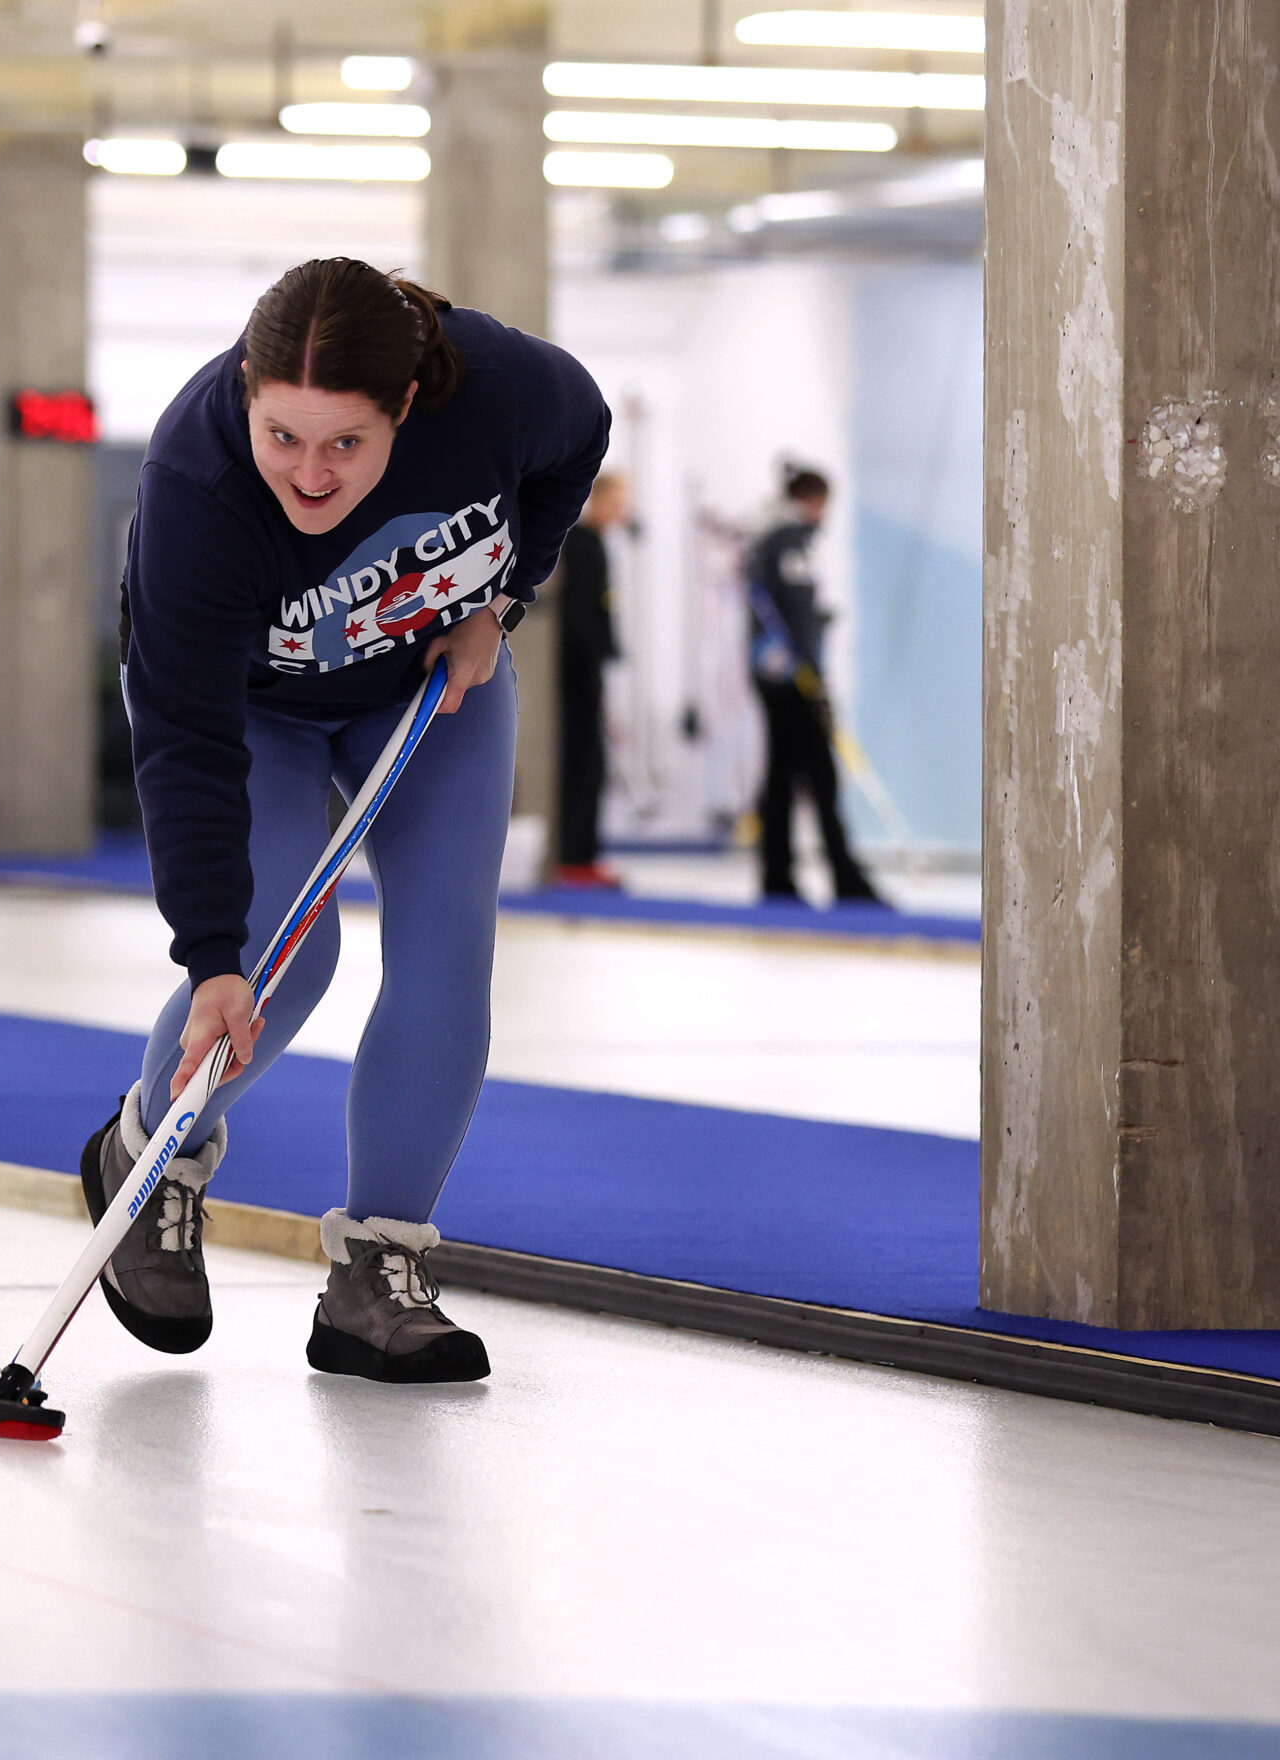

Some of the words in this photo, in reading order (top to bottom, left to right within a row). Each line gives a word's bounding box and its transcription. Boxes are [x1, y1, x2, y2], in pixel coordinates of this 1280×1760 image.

[281, 547, 400, 628] WINDY
[414, 493, 502, 562] CITY
[127, 1134, 179, 1220] Goldline
